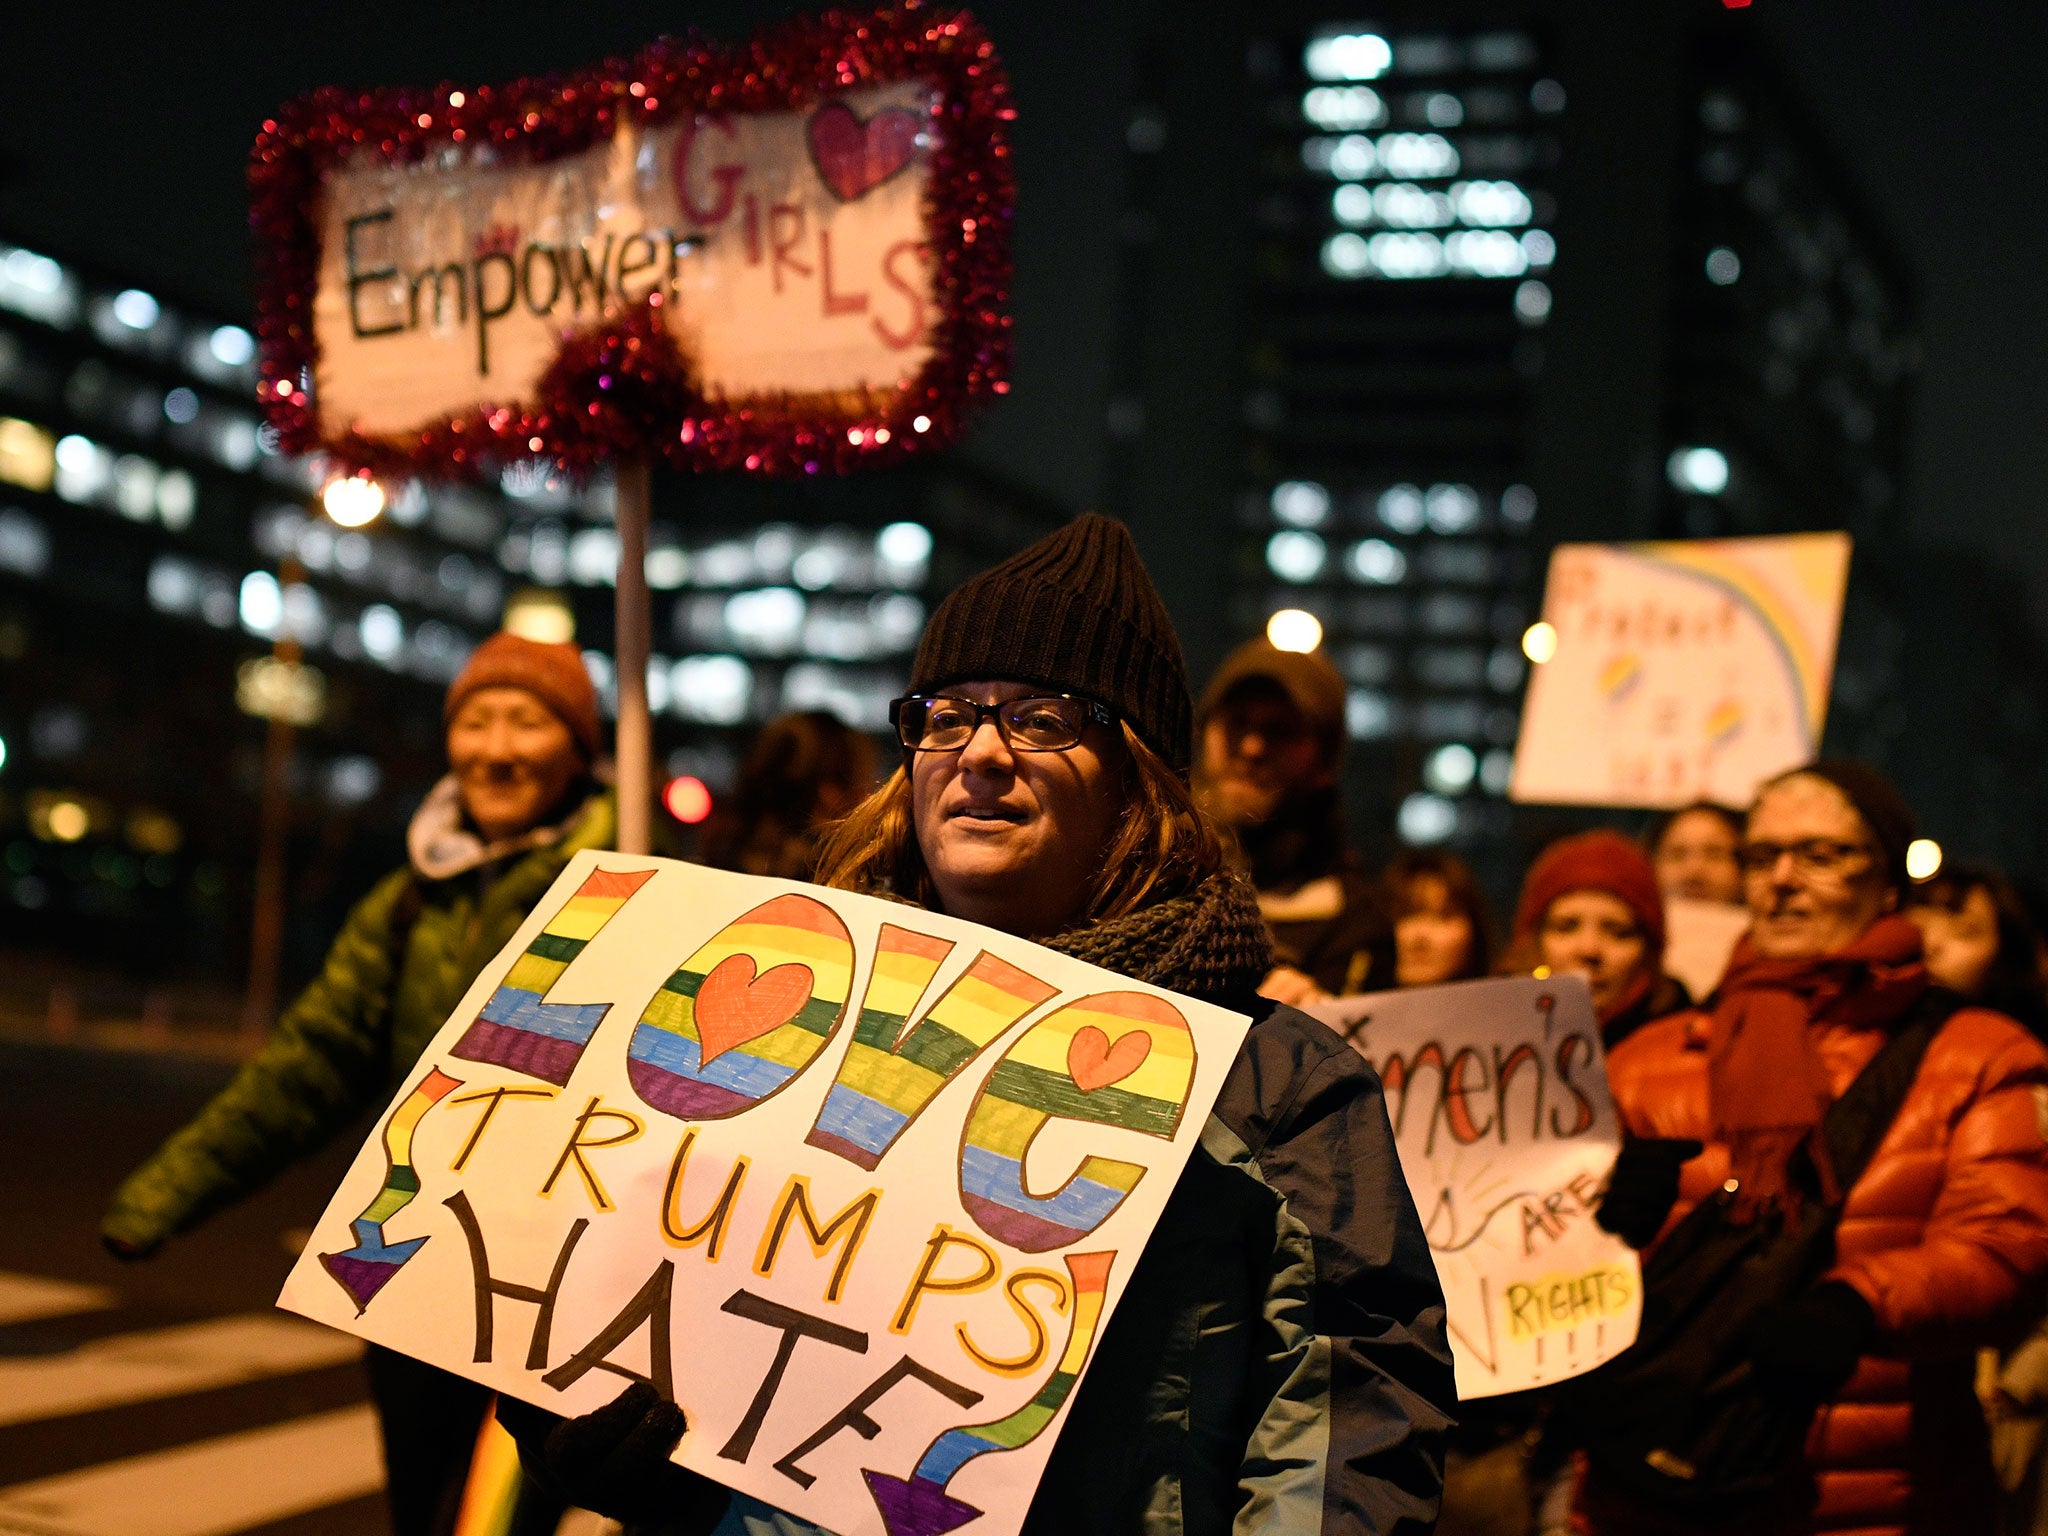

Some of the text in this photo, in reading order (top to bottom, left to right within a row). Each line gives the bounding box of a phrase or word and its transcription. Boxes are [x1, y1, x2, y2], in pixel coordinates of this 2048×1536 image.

[345, 208, 706, 375] Empower
[447, 1085, 1073, 1379] TRUMPS
[1521, 1172, 1604, 1257] ARE
[442, 1190, 984, 1490] HATE
[1505, 1270, 1634, 1338] RIGHTS
